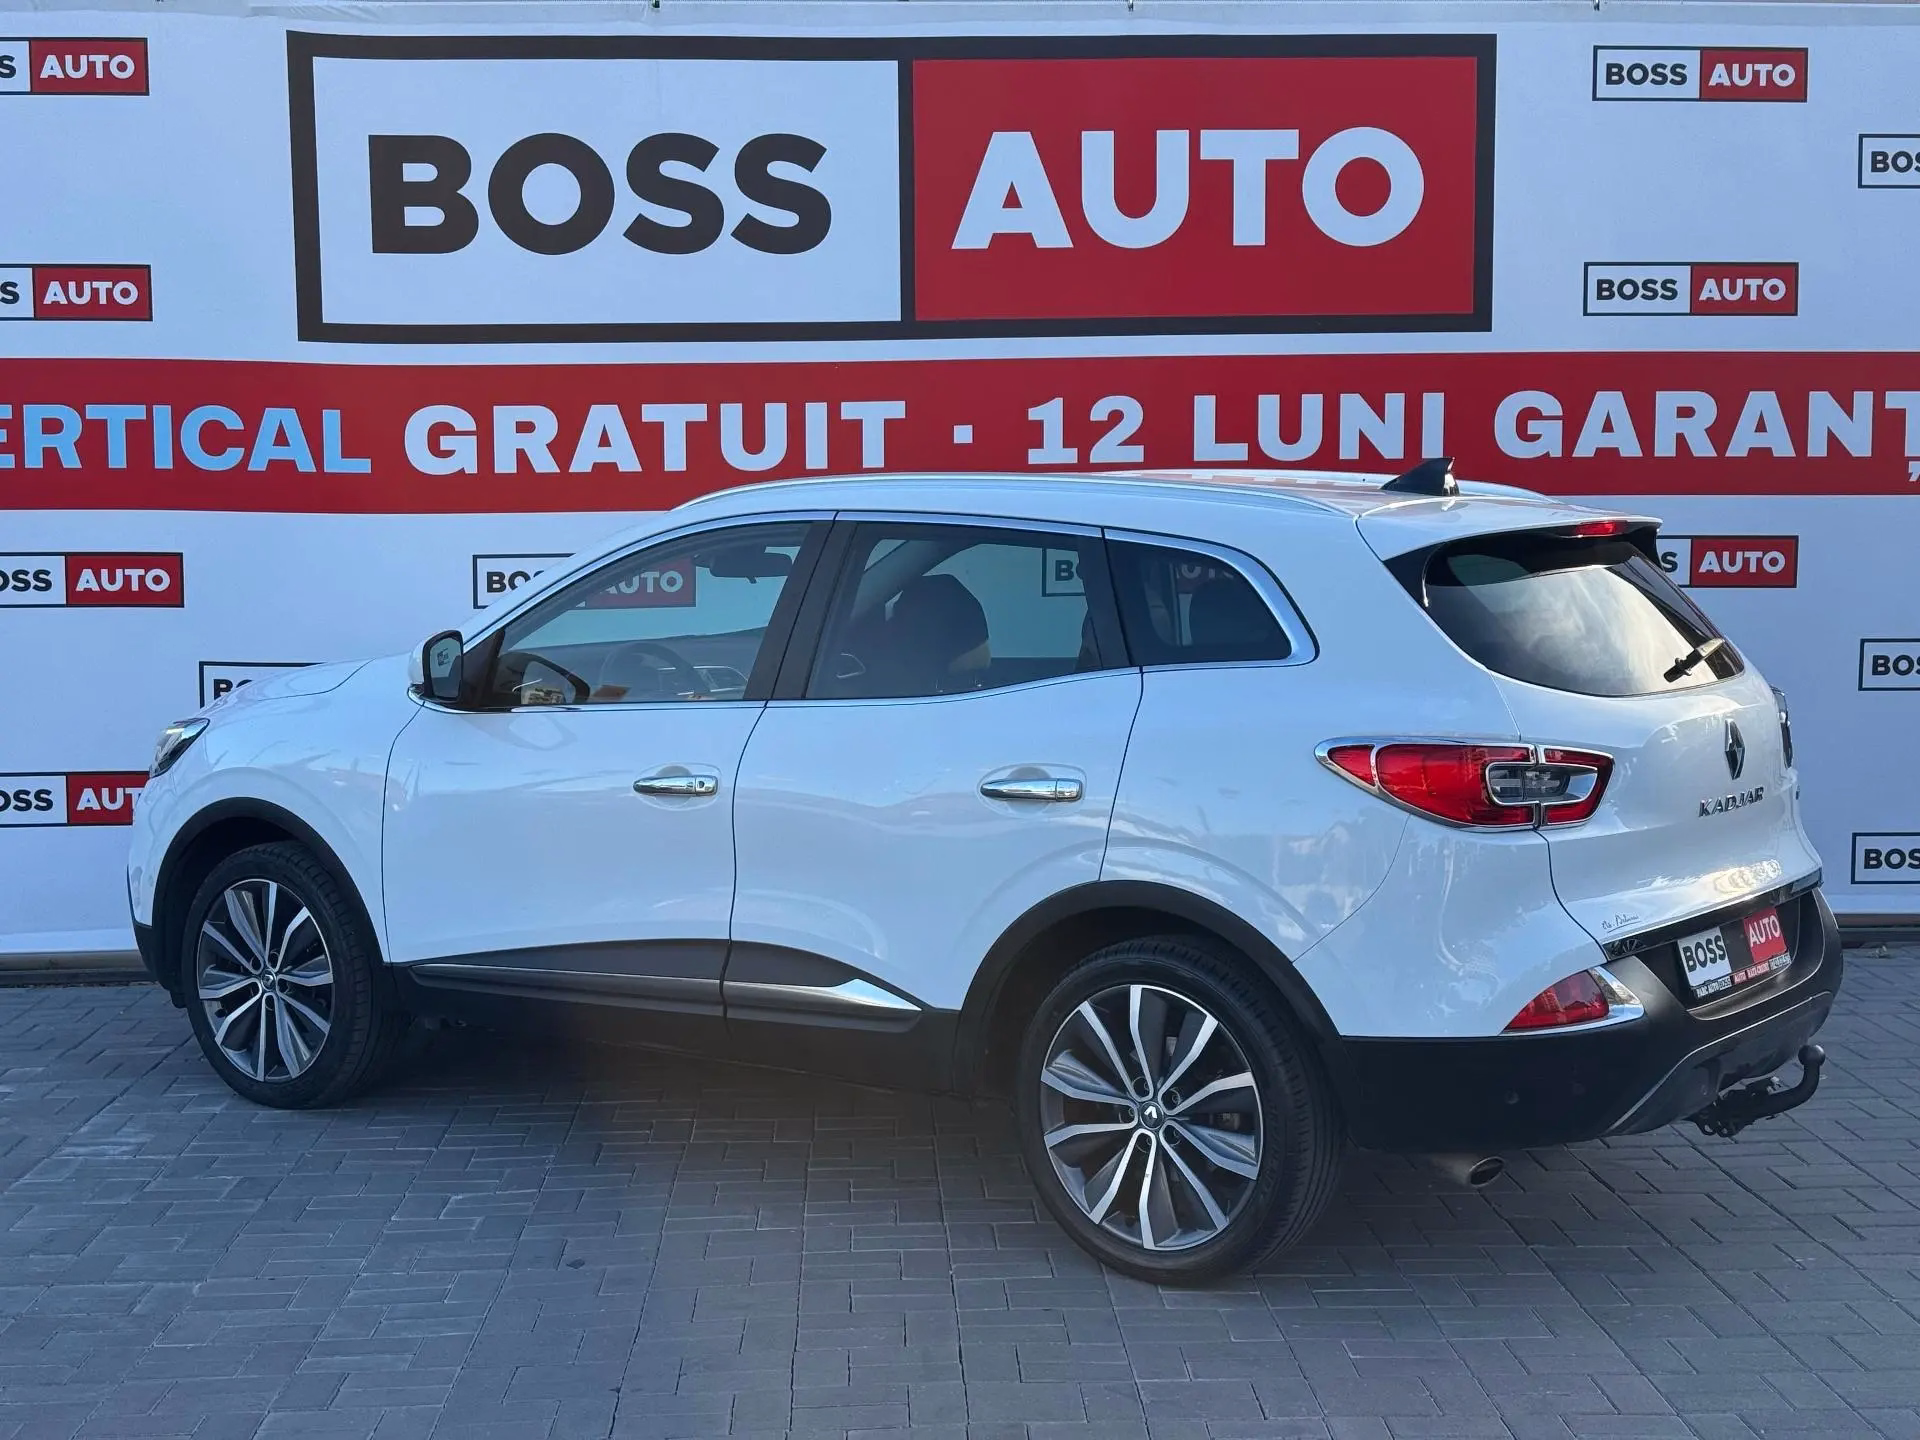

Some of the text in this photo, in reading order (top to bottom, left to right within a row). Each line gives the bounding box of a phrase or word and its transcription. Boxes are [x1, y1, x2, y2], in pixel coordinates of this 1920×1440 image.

[40, 55, 135, 79] AUTO
[1605, 62, 1796, 87] BOSS AUTO
[1871, 150, 1920, 173] BO
[368, 126, 1425, 256] BOSS AUTO
[43, 280, 139, 305] AUTO
[1596, 278, 1786, 301] BOSS AUTO
[404, 402, 906, 474] GRATUIT
[1027, 395, 1145, 465] 12
[1193, 392, 1445, 462] LUNI
[1698, 551, 1786, 573] AUTO
[75, 568, 171, 592] AUTO
[1872, 654, 1920, 676] BO
[1699, 786, 1764, 817] KADJAR
[1682, 935, 1726, 972] BOSS
[1749, 915, 1780, 947] AUTO
